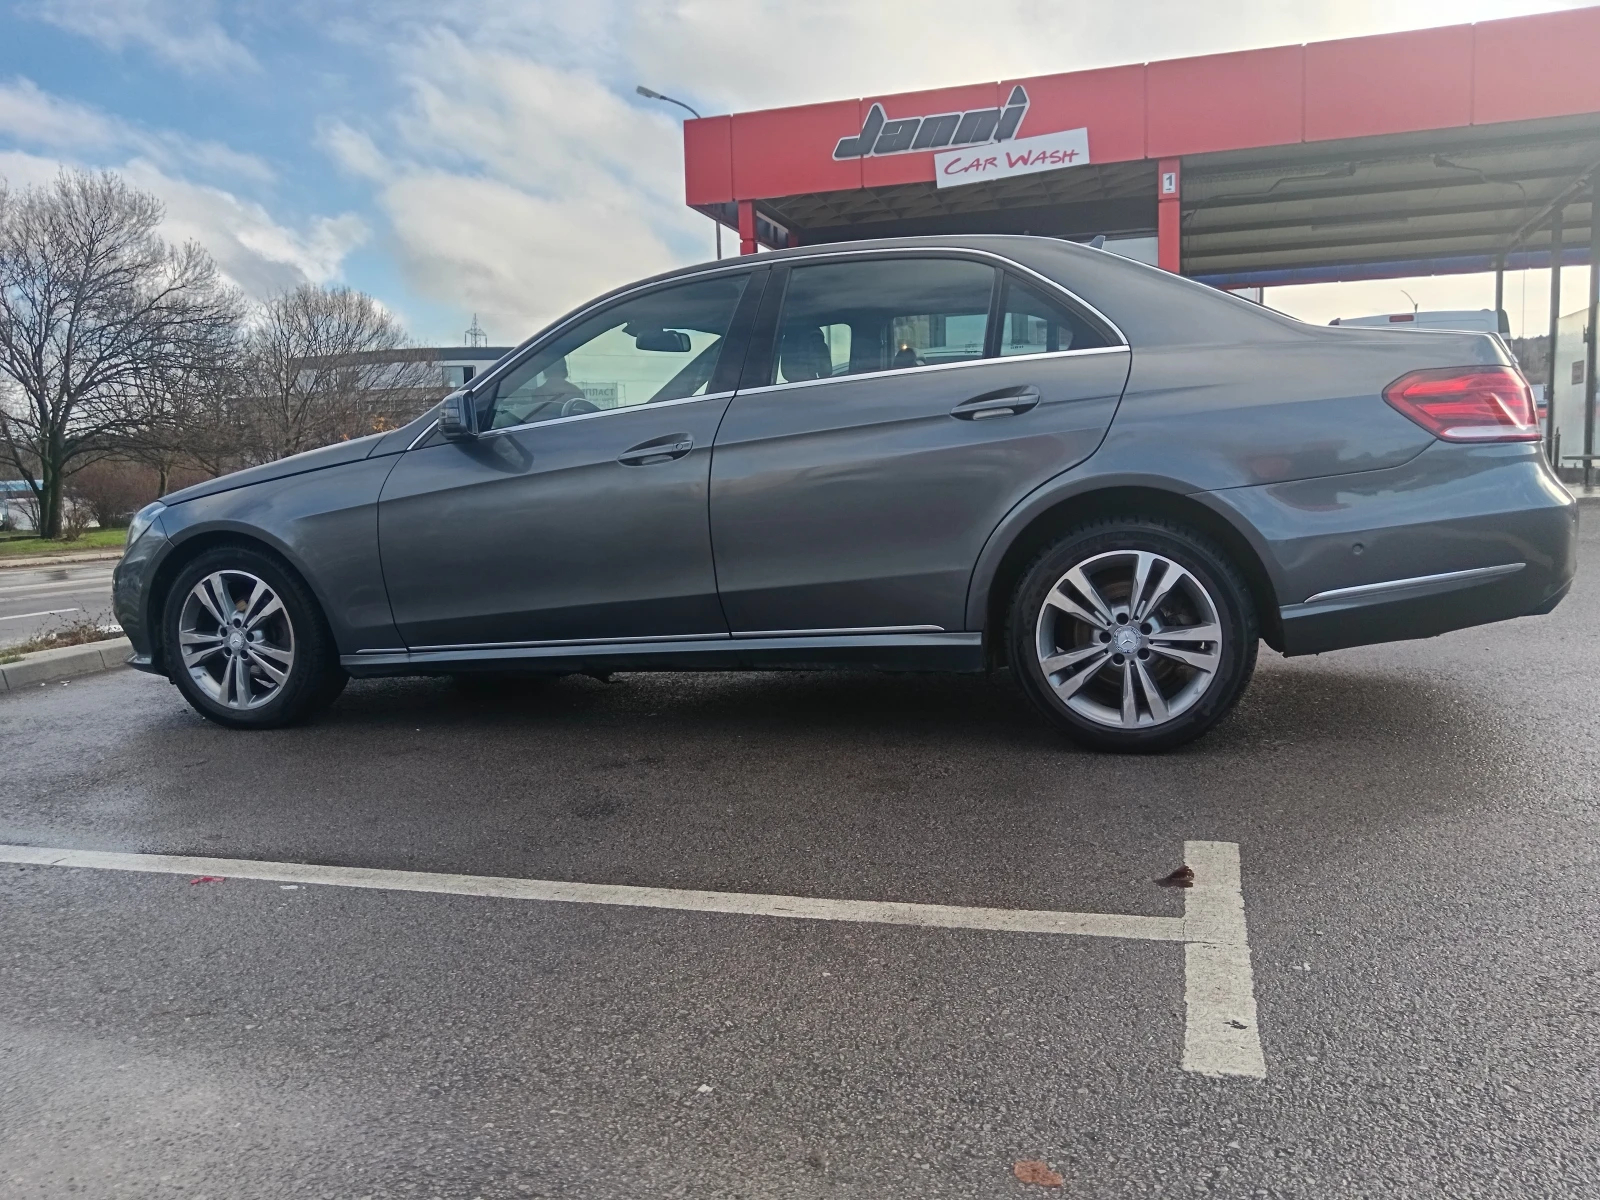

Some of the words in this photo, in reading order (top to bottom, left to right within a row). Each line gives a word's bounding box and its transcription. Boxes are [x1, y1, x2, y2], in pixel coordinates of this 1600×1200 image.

[944, 157, 998, 175] CAR
[1005, 149, 1080, 168] WASH
[1165, 174, 1173, 186] 1
